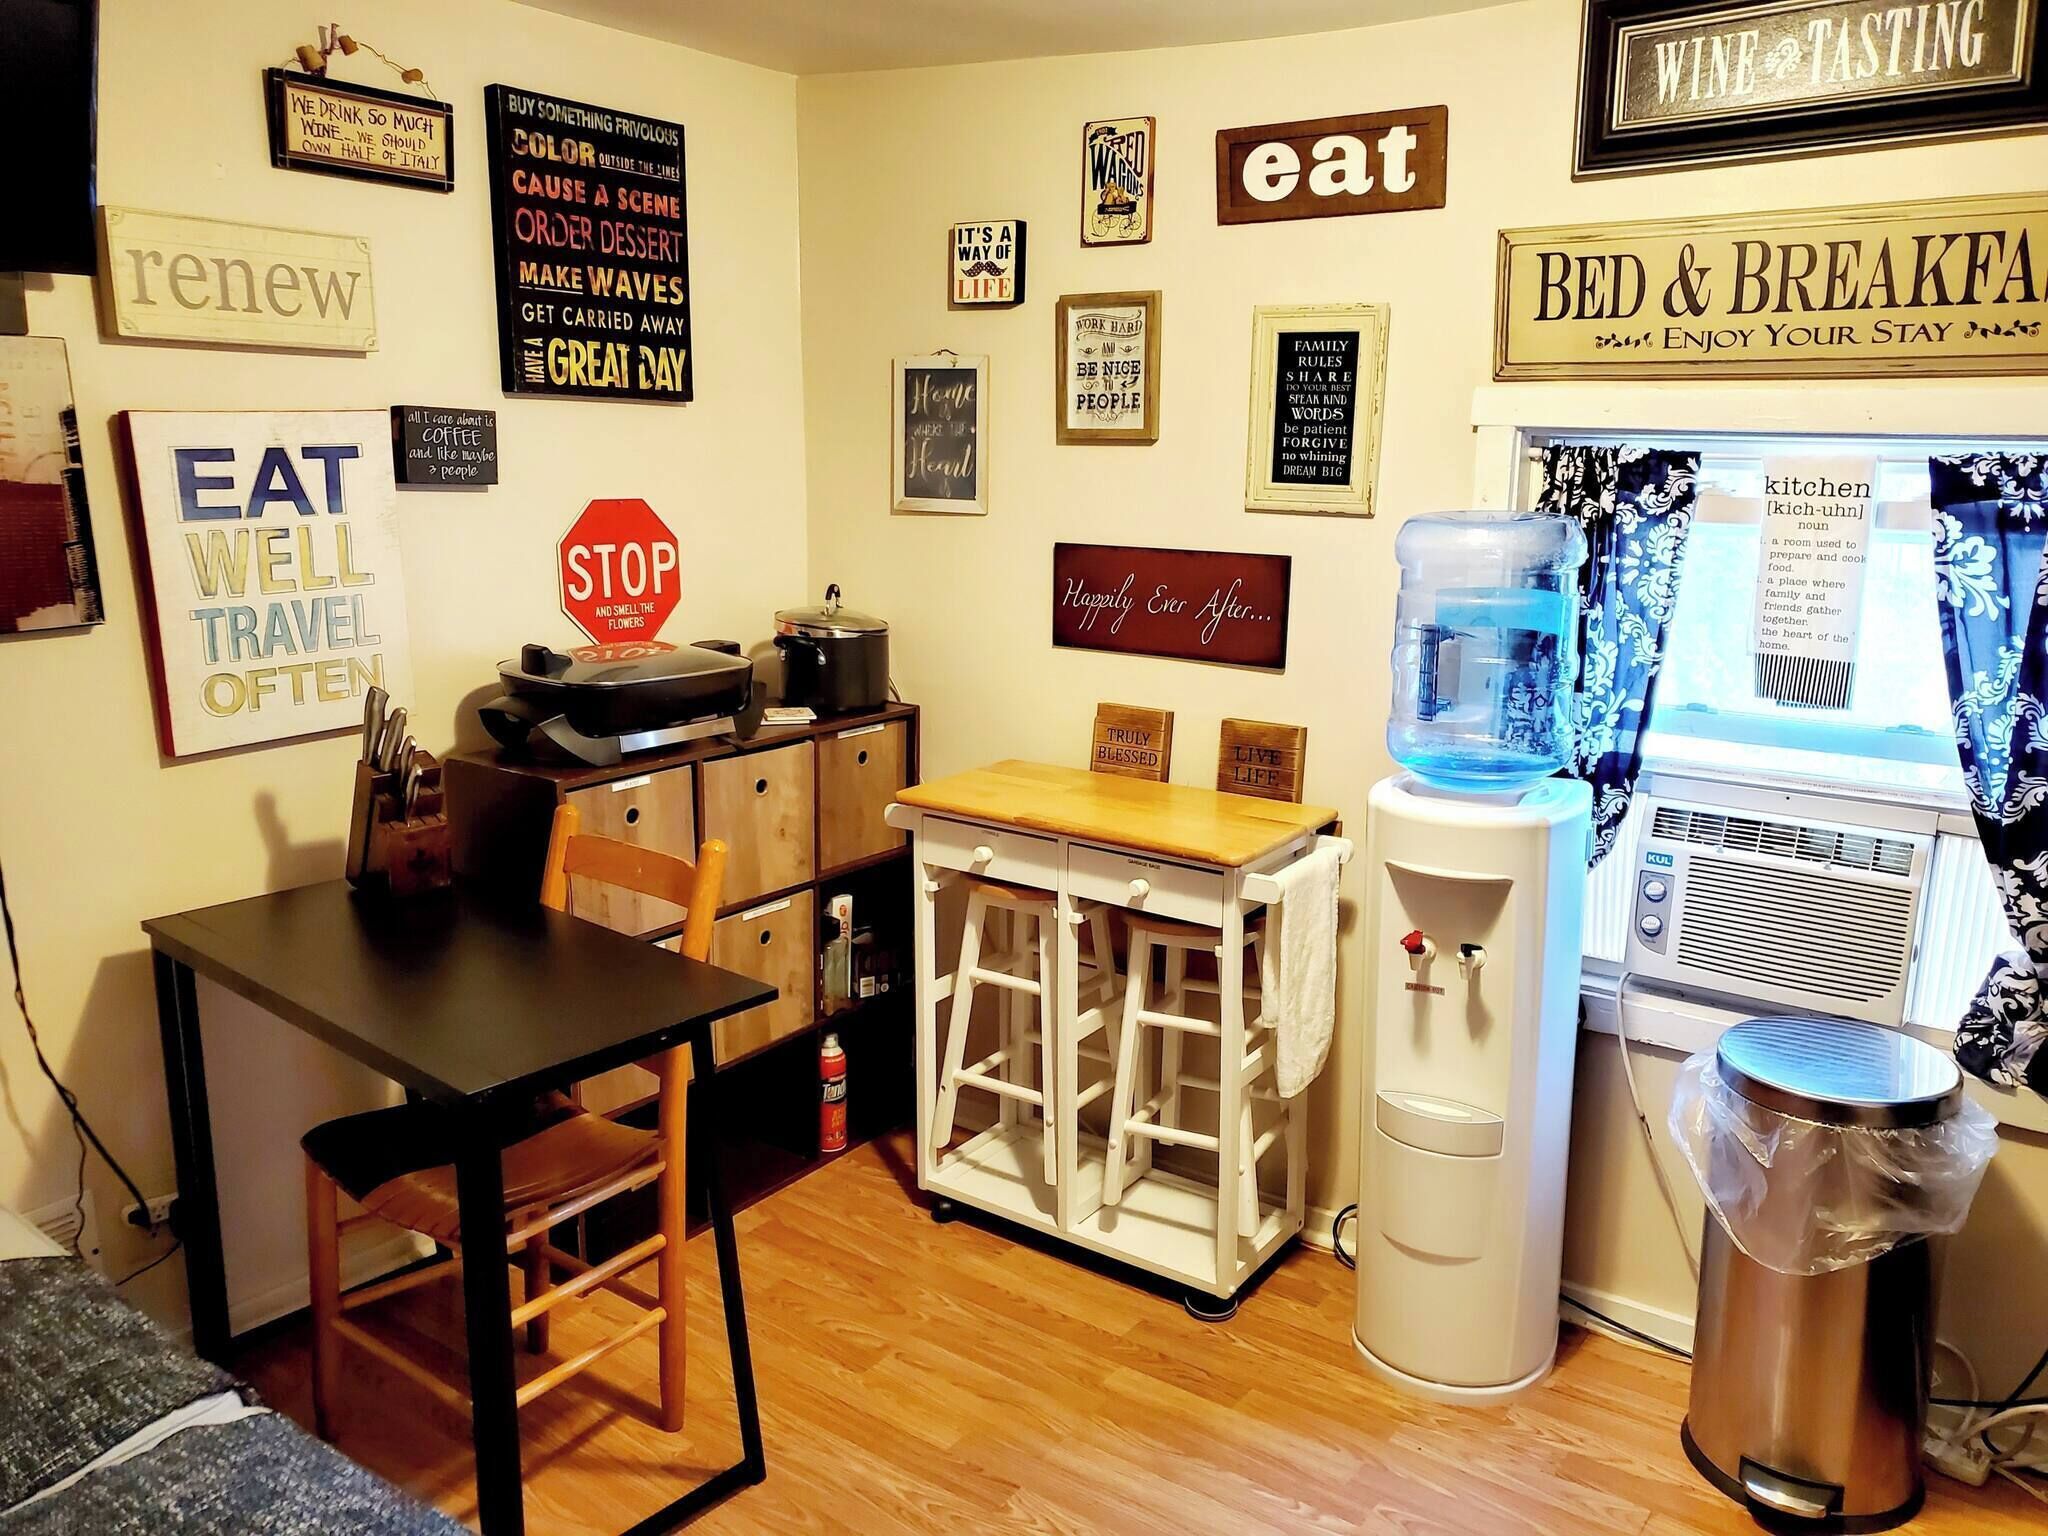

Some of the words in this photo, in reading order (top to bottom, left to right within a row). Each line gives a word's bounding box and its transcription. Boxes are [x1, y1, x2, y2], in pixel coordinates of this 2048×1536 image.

[1655, 29, 1760, 105] WINE
[1807, 0, 1985, 84] TASTING
[291, 93, 315, 115] WE
[393, 112, 433, 140] MUCH
[508, 94, 536, 117] BUY
[538, 101, 613, 134] SOMETHING
[615, 117, 679, 147] FRIVOLOUS
[357, 131, 376, 146] WE
[382, 133, 426, 152] SHOULD
[302, 140, 331, 155] OWN
[341, 143, 375, 161] HALF
[382, 150, 396, 165] OF
[400, 150, 440, 170] ITALY
[512, 128, 596, 168] COLOR
[600, 152, 635, 170] OUTSIDE
[638, 160, 654, 174] THE
[657, 164, 681, 179] LINES
[1242, 126, 1417, 202] eat
[512, 169, 586, 204] CAUSE
[594, 184, 609, 208] A
[617, 187, 681, 219] SCENE
[515, 207, 595, 251] ORDER
[600, 220, 683, 263] DESSERT
[958, 227, 992, 245] IT'S
[1000, 226, 1011, 242] A
[958, 245, 991, 261] WAY
[996, 244, 1012, 260] OF
[519, 261, 583, 290] MAKE
[587, 265, 684, 305] WAVES
[1533, 252, 1646, 321] BED
[1663, 243, 1713, 319] &
[1726, 227, 2048, 315] BREAKFA
[125, 249, 361, 321] renew
[958, 278, 1011, 299] LIFE
[522, 302, 554, 324] GET
[562, 306, 633, 331] CARRIED
[640, 314, 684, 336] AWAY
[1075, 318, 1106, 331] WORK
[1111, 319, 1143, 334] HARD
[524, 337, 543, 347] A
[1662, 325, 1756, 354] ENJOY
[1764, 323, 1862, 348] YOUR
[1871, 318, 1955, 344] STAY
[1294, 340, 1349, 352] FAMILY
[524, 350, 545, 383] HAVE
[547, 337, 630, 388] GREAT
[637, 345, 686, 392] DAY
[1077, 362, 1098, 377] BE
[1102, 360, 1141, 376] NICE
[1298, 355, 1343, 368] RULES
[1286, 383, 1300, 392] DO
[1302, 383, 1327, 392] YOUR
[1331, 384, 1351, 392] BEST
[1077, 392, 1141, 410] PEOPLE
[1288, 393, 1320, 405] SPEAK
[1323, 393, 1348, 405] KIND
[408, 410, 420, 424] all
[423, 411, 430, 424] I
[433, 414, 454, 425] care
[456, 413, 482, 427] about
[484, 415, 494, 427] is
[1291, 407, 1344, 421] WORDS
[422, 426, 482, 446] COFFEE
[1284, 423, 1299, 434] be
[1303, 423, 1348, 436] patient
[1282, 436, 1348, 449] FORGIVE
[409, 446, 433, 459] and
[437, 446, 458, 460] like
[462, 448, 496, 463] maybe
[1282, 452, 1297, 461] no
[1300, 450, 1347, 465] whining
[441, 464, 478, 480] people
[1283, 464, 1317, 478] DREAM
[1322, 466, 1343, 477] BIG
[169, 443, 363, 523] EAT
[1765, 476, 1871, 498] kitchen
[1767, 500, 1864, 520] [kich-uhn]
[1798, 521, 1829, 531] noun
[1784, 538, 1811, 548] room
[1816, 539, 1841, 548] used
[1846, 541, 1857, 549] to
[184, 522, 375, 600] WELL
[1769, 551, 1812, 561] prepare
[1816, 553, 1837, 562] and
[1842, 554, 1867, 563] cook
[567, 541, 677, 601] STOP
[1779, 577, 1807, 586] place
[1812, 579, 1846, 589] where
[1062, 573, 1135, 635] Happily
[1147, 584, 1187, 614] Ever
[1765, 589, 1800, 601] family
[1805, 592, 1826, 601] and
[595, 605, 613, 618] AND
[613, 603, 640, 617] SMELL
[640, 602, 656, 613] THE
[1764, 602, 1802, 612] friends
[1806, 605, 1842, 615] gather
[189, 594, 382, 665] TRAVEL
[608, 617, 645, 630] FLOWERS
[1762, 628, 1778, 636] the
[1783, 629, 1812, 640] heart
[1817, 633, 1829, 641] of
[1833, 634, 1849, 643] the
[199, 653, 385, 717] OFTEN
[1107, 727, 1151, 747] TRULY
[1097, 746, 1158, 767] BLESSED
[1234, 746, 1282, 766] LIVE
[1233, 767, 1280, 786] LIFE
[1648, 854, 1671, 865] KUL
